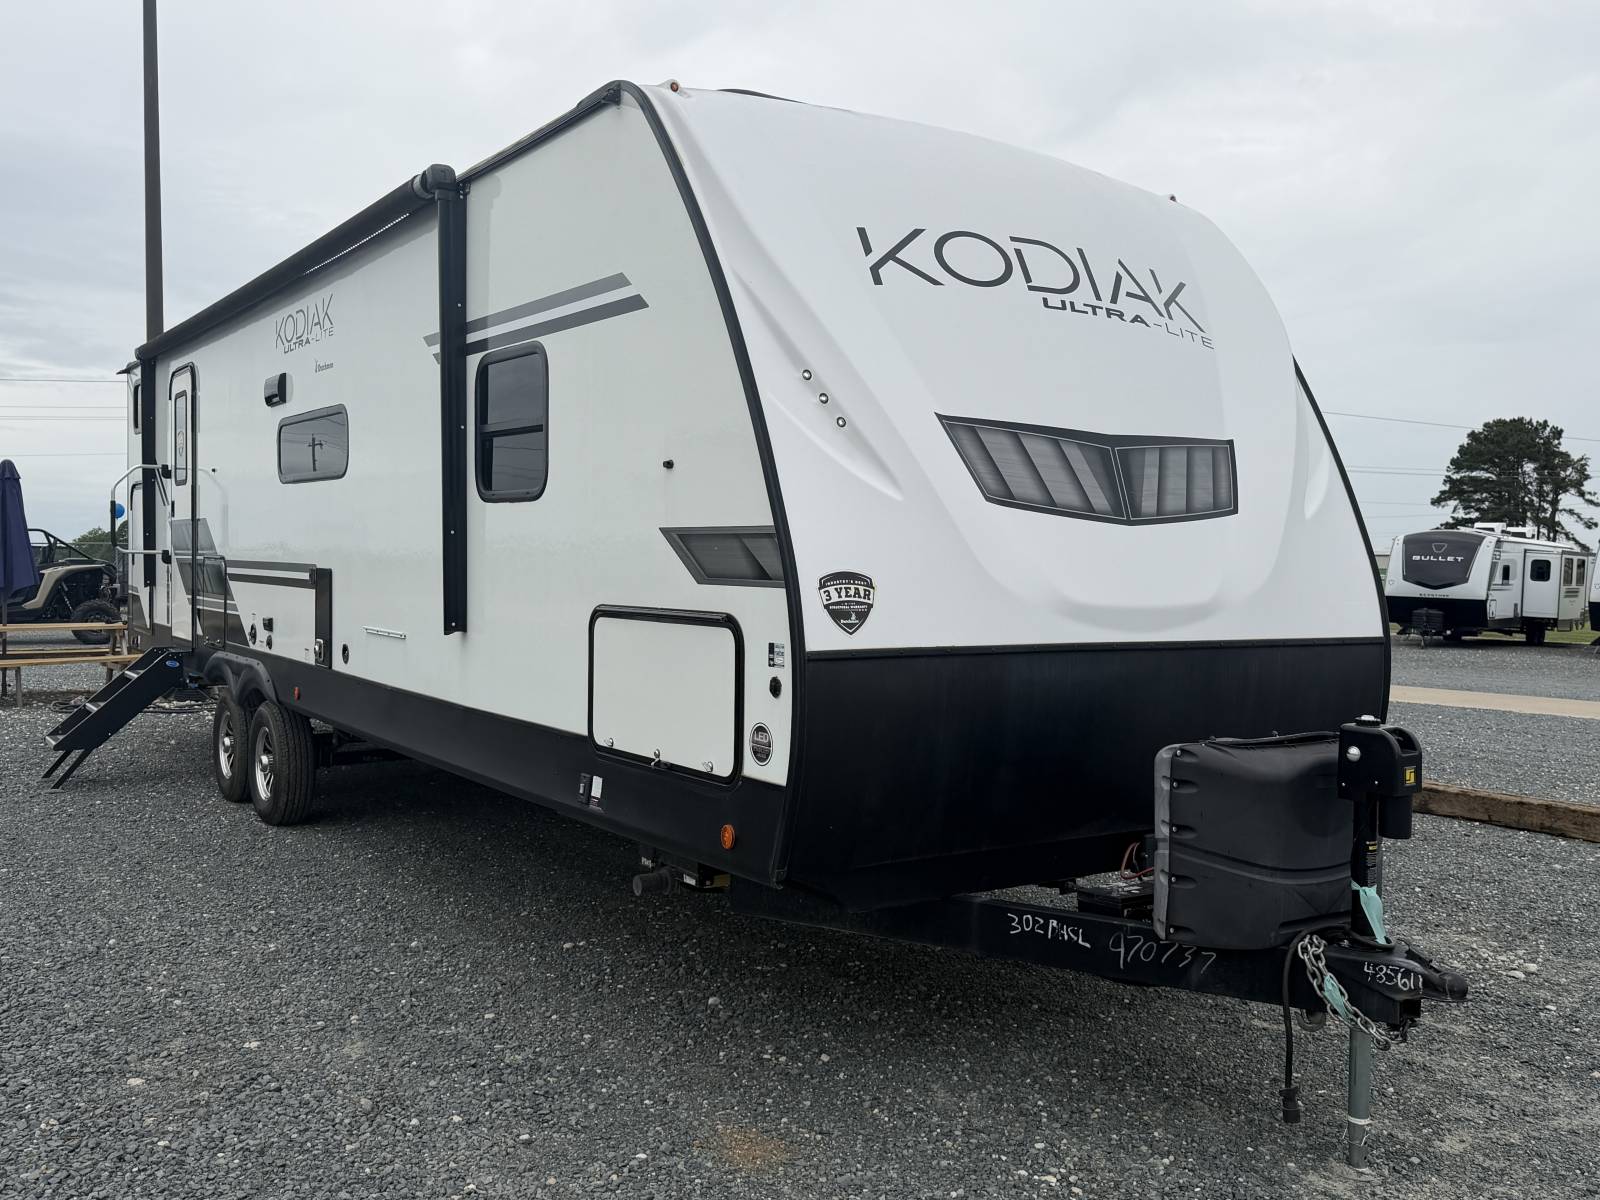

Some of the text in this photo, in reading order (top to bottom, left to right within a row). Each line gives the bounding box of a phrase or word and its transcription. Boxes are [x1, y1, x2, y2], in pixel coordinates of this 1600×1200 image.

[856, 227, 1206, 333] KODIAK
[275, 293, 334, 350] KODIAK
[283, 327, 335, 354] ULTRA-LITE
[1042, 297, 1215, 350] ULTRA-LITE
[823, 586, 871, 602] 3 YEAR
[754, 731, 769, 743] LED
[1108, 931, 1217, 975] 970737
